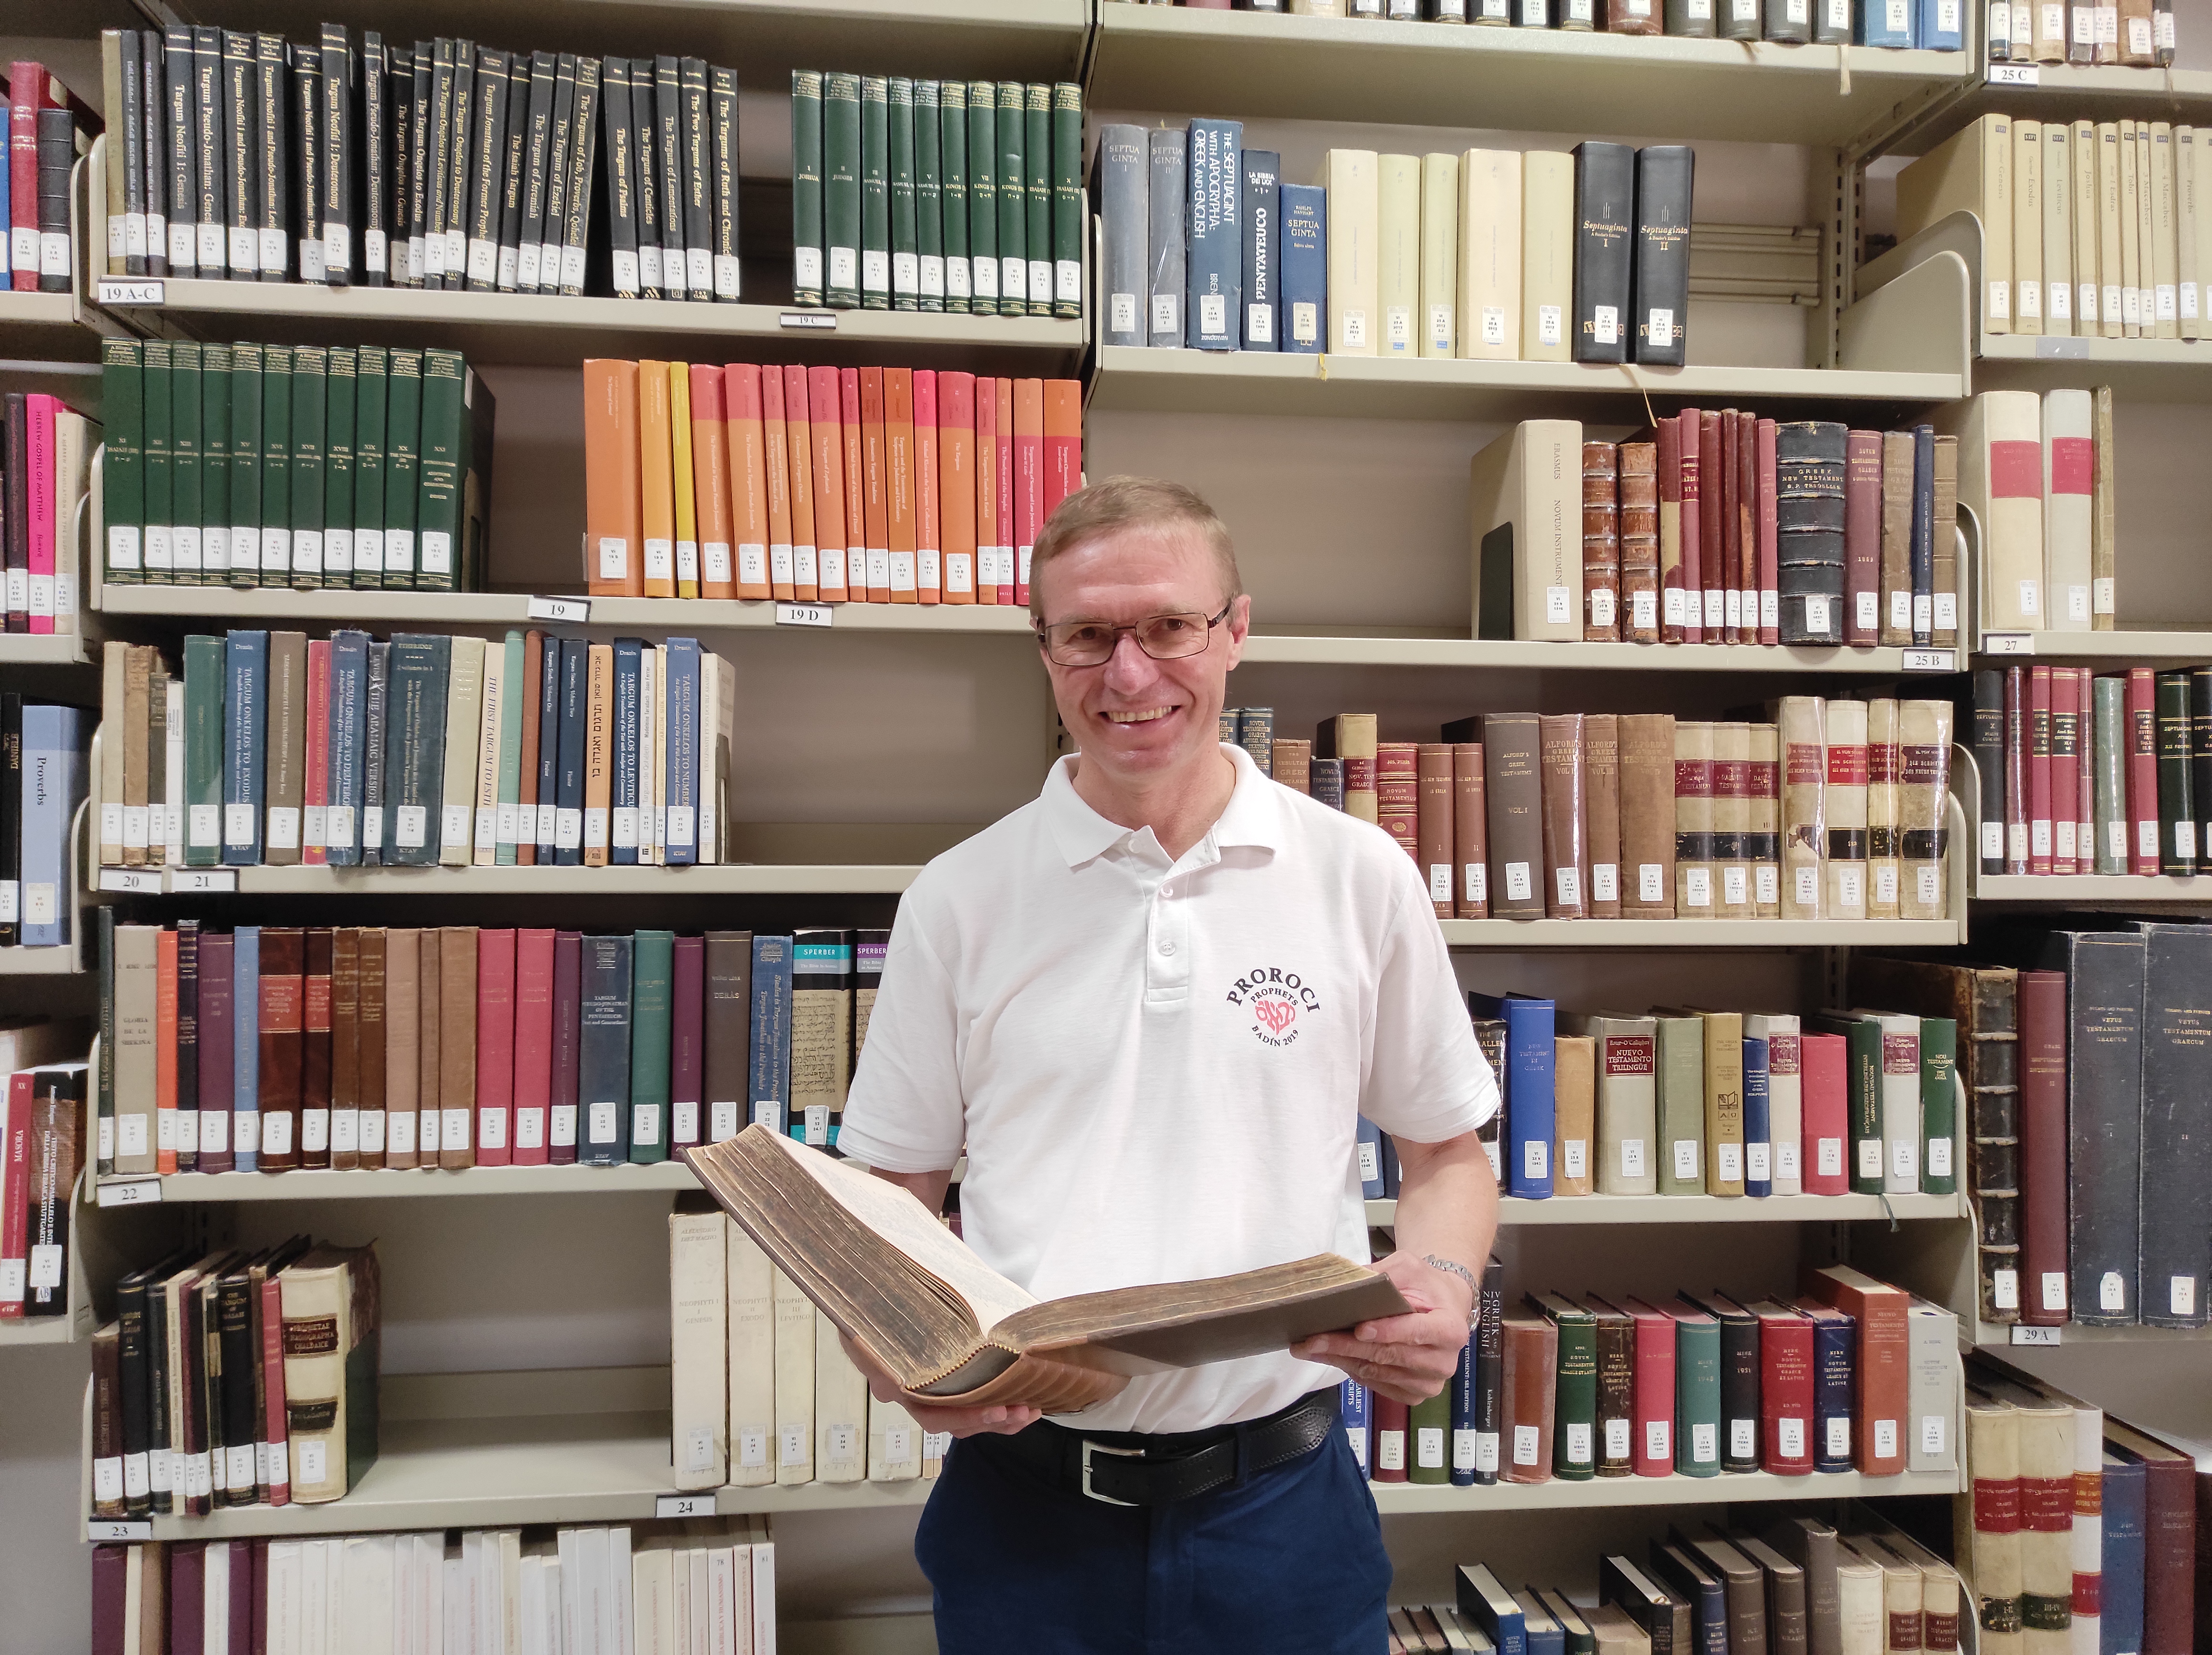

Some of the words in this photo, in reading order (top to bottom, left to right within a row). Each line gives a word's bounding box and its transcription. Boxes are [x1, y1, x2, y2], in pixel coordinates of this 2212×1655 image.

[201, 66, 212, 104] Targum
[2001, 70, 2015, 80] 25
[2018, 70, 2028, 81] C
[175, 85, 185, 122] Targum
[720, 101, 729, 117] The
[536, 114, 545, 129] The
[176, 125, 185, 159] Neofiti
[203, 106, 214, 190] Pseudo-Jonathan:
[533, 131, 543, 166] Targum
[719, 121, 729, 160] Targums
[1109, 145, 1139, 154] SEPTUA
[1153, 146, 1183, 155] SEPTUA
[1194, 129, 1206, 168] GREEK
[1209, 131, 1218, 156] WITH
[1224, 132, 1232, 151] THE
[511, 151, 521, 176] Isaiah
[1112, 155, 1138, 163] GINTA
[1155, 156, 1181, 165] GINTA
[177, 174, 186, 209] Genesis
[508, 178, 517, 208] Targum
[721, 174, 730, 197] Ruth
[1223, 153, 1235, 225] SEPTUAGINT
[205, 194, 214, 224] Genesi
[529, 180, 541, 218] Jeremiah
[722, 200, 731, 216] and
[1194, 190, 1206, 239] ENGLISH
[1288, 219, 1320, 228] SEPTUA
[722, 220, 732, 255] Chronic
[1291, 228, 1316, 237] GINTA
[1583, 220, 1628, 233] Septuaginta
[1640, 225, 1688, 236] Septuaginta
[1255, 208, 1267, 300] PENTATEUCO
[106, 288, 121, 299] 19
[126, 288, 155, 300] A-C
[37, 472, 42, 481] OF
[1554, 500, 1562, 532] NOVUM
[551, 604, 564, 615] 19
[790, 609, 804, 620] 19
[809, 610, 818, 620] D
[2005, 641, 2017, 651] 27
[1915, 655, 1928, 665] 25
[1931, 656, 1940, 665] B
[489, 677, 497, 696] THE
[627, 672, 635, 709] TARGUM
[488, 698, 496, 724] FIRST
[593, 703, 602, 732] תרגום
[243, 707, 251, 748] ONKELOS
[369, 711, 379, 758] ARAMAIC
[627, 711, 635, 751] ONKELOS
[486, 725, 495, 767] TARGUM
[243, 752, 251, 764] TO
[627, 753, 635, 765] TO
[36, 757, 47, 806] Proverbs
[242, 767, 251, 804] EXODUS
[485, 768, 492, 780] TO
[483, 782, 492, 806] ESTH
[627, 766, 635, 807] LEVITICU
[123, 876, 140, 887] 20
[194, 876, 210, 887] 21
[1226, 967, 1320, 1012] PROROCI
[1250, 988, 1298, 1006] PROPHETS
[1251, 1025, 1280, 1047] BADÍN
[1283, 1030, 1298, 1045] 2019
[14, 1129, 23, 1163] MASORA
[121, 1188, 137, 1200] 22
[1483, 1290, 1500, 1299] NIV
[1482, 1300, 1490, 1348] ENGLISH
[1491, 1300, 1500, 1336] GREEK
[2025, 1330, 2036, 1341] 29
[2039, 1330, 2048, 1341] A
[678, 1502, 694, 1512] 24
[111, 1527, 128, 1536] 23
